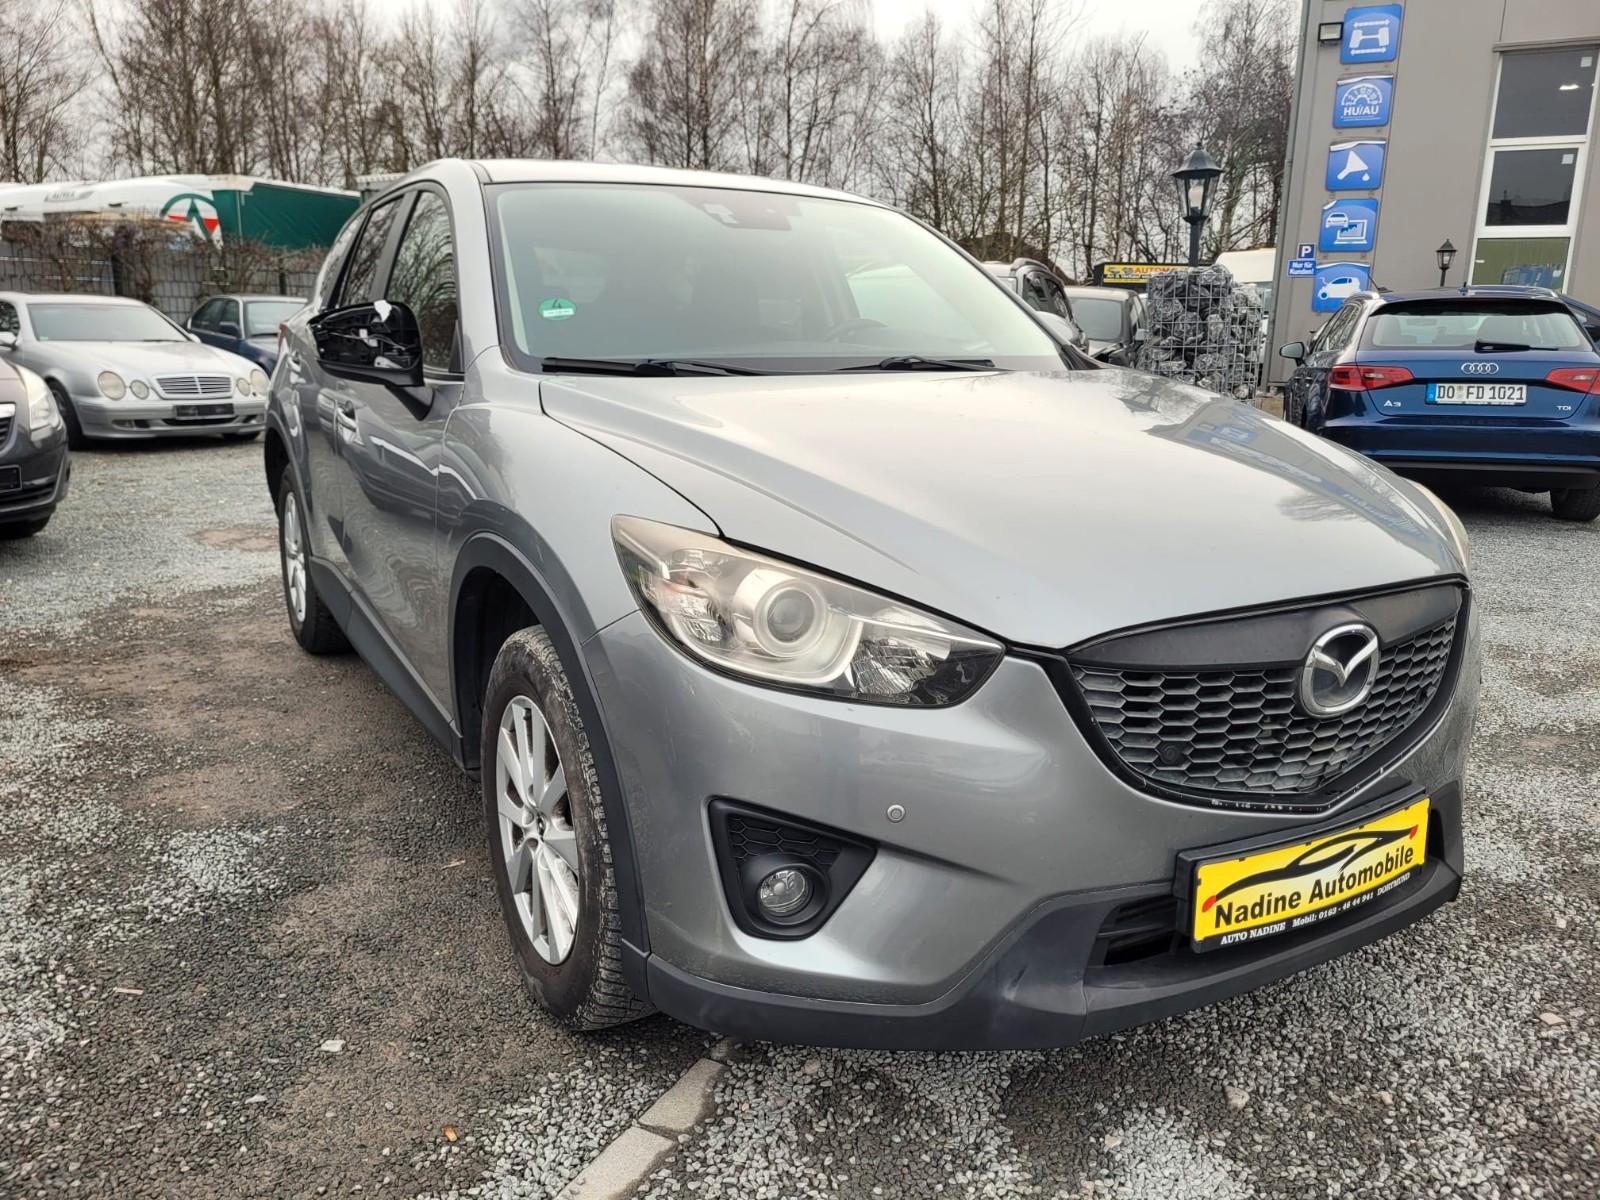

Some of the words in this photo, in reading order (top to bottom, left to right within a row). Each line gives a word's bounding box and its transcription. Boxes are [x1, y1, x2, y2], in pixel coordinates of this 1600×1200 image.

[1343, 106, 1379, 116] HU/AU
[1301, 245, 1311, 257] P
[1437, 385, 1455, 399] DO
[1466, 386, 1484, 400] FD
[1489, 386, 1524, 401] 1021
[1215, 891, 1301, 928] Nadine
[1308, 846, 1414, 904] Automobile
[1221, 931, 1248, 945] AUTO
[1249, 922, 1286, 939] NADINE
[1292, 913, 1317, 928] Mobil:
[1377, 872, 1411, 896] DORTMUND
